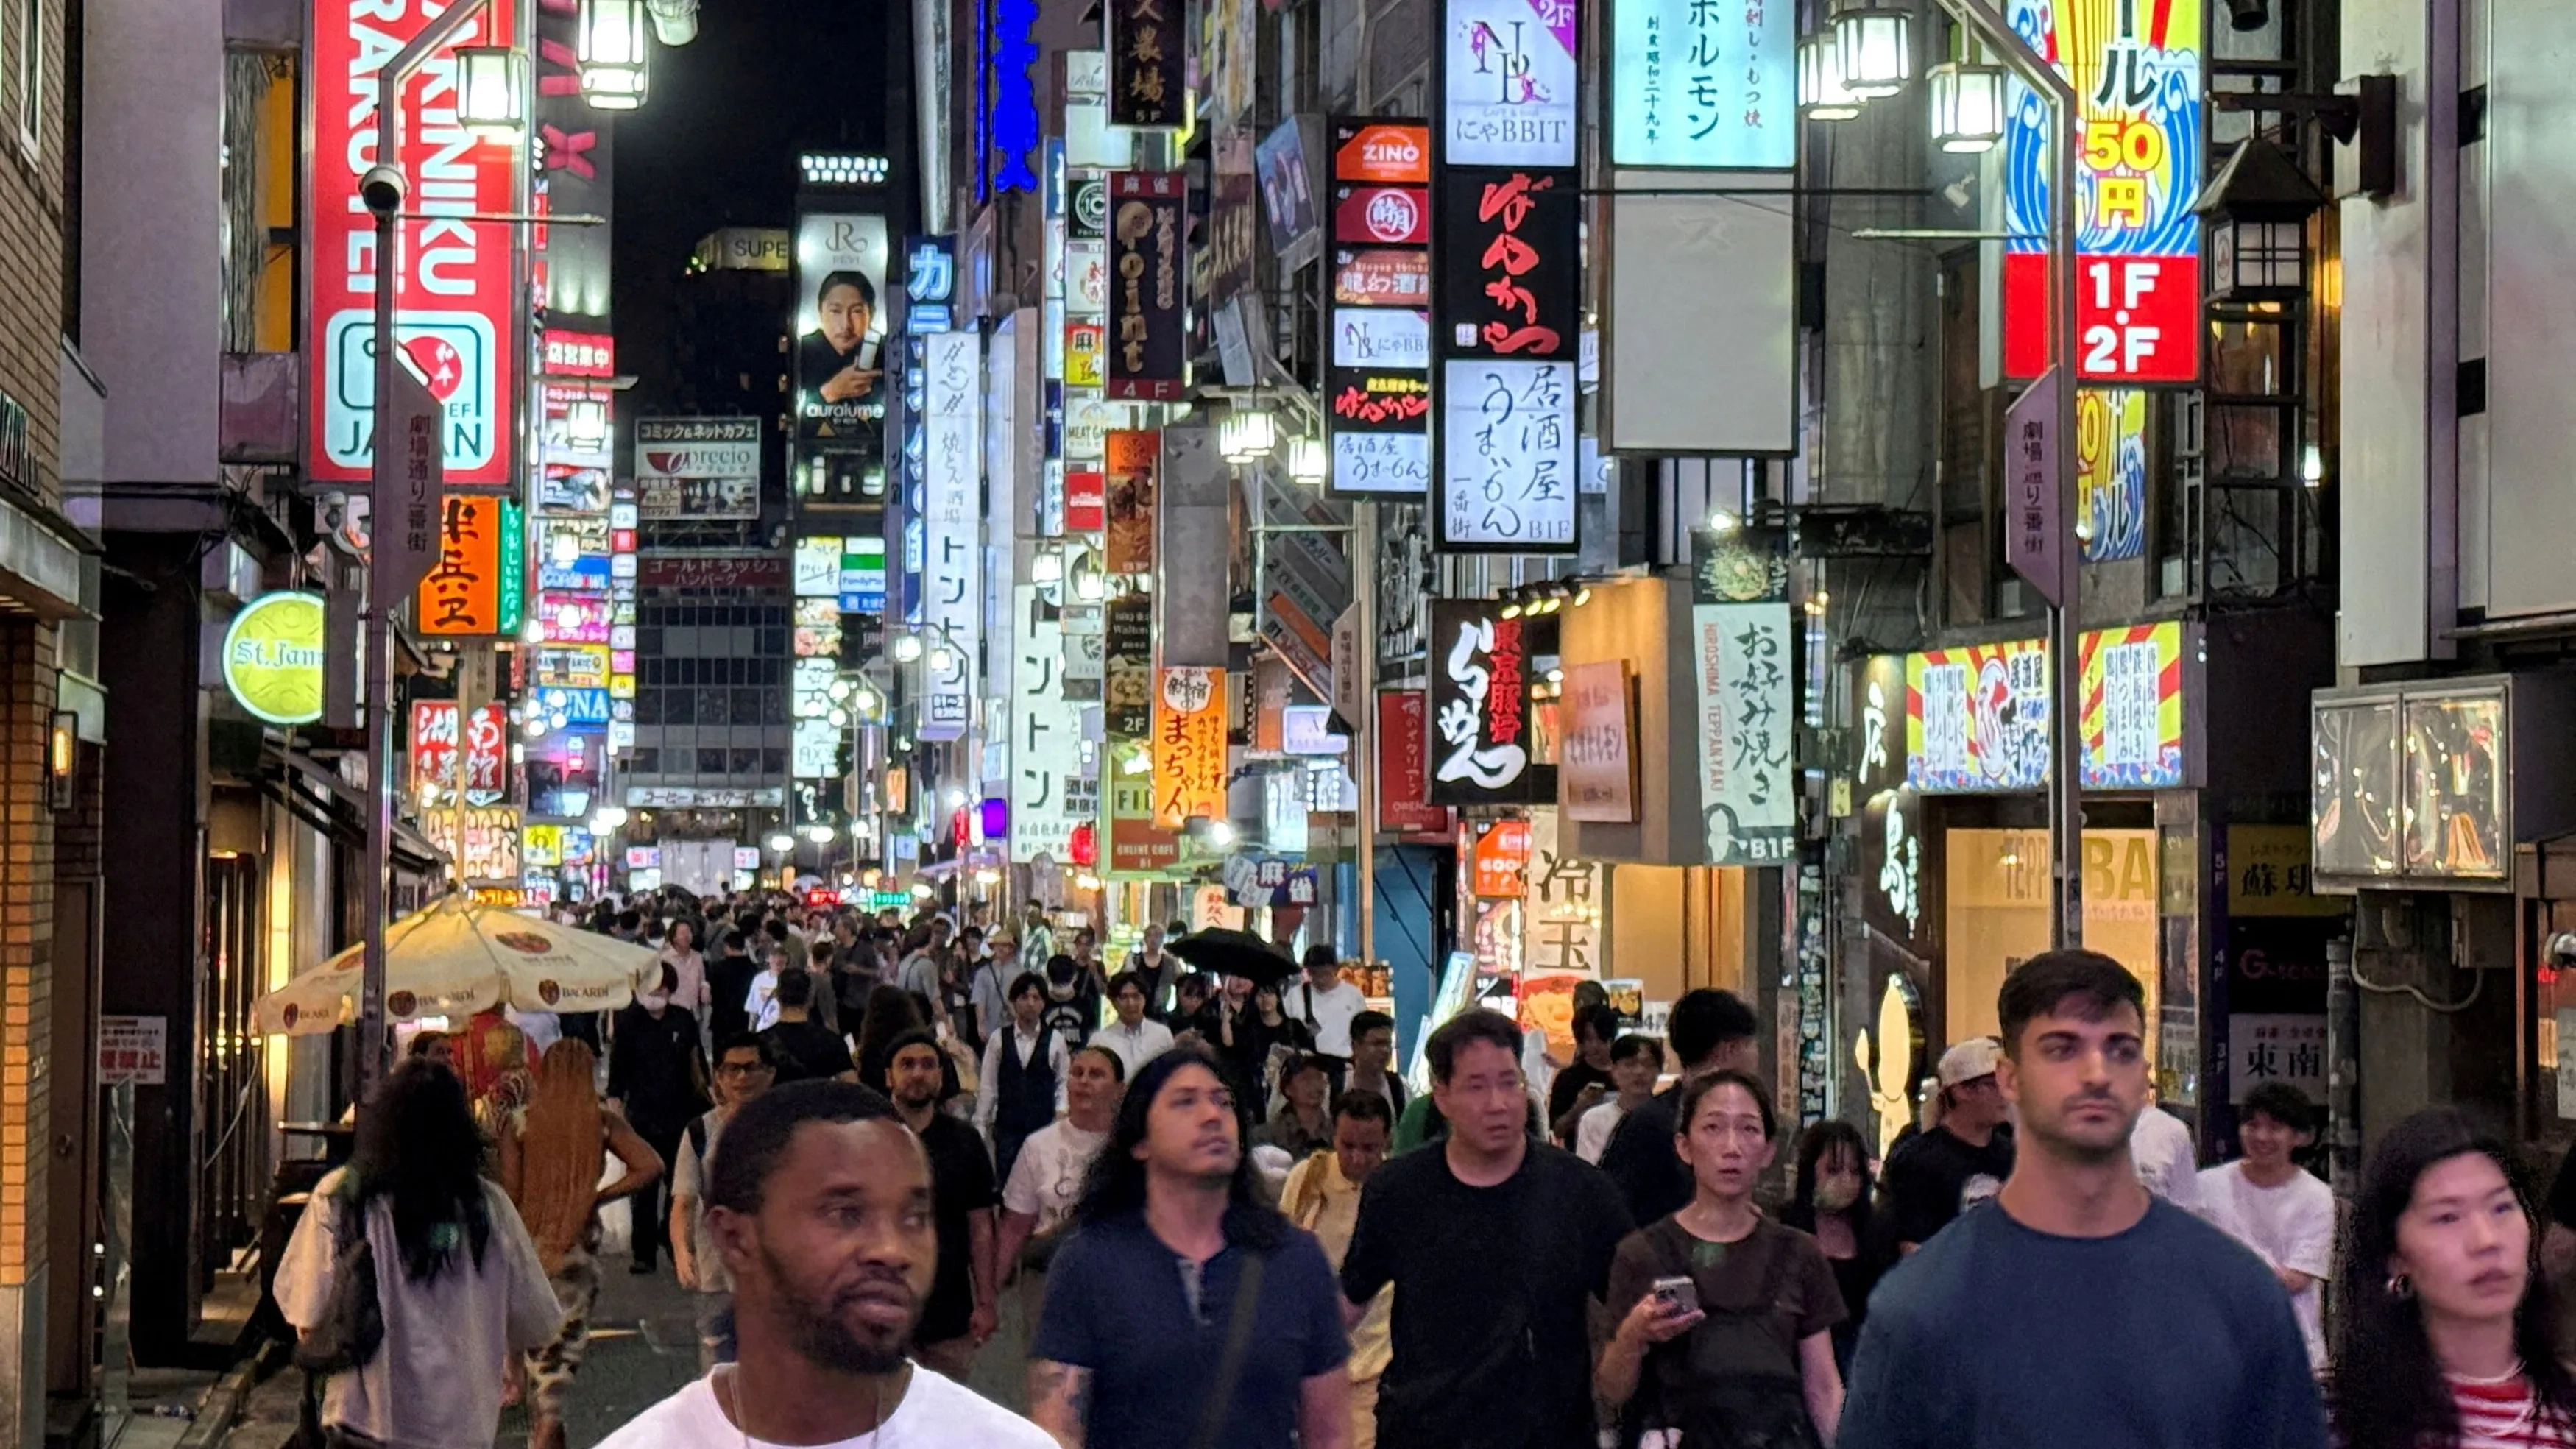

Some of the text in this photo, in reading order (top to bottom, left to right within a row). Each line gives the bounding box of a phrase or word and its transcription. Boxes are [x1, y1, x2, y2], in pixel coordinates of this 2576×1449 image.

[1688, 0, 1720, 140] ホルモン
[1362, 144, 1420, 163] ZINO
[1456, 118, 1567, 144] にゃBBIT
[2089, 262, 2161, 309] 1F
[2084, 326, 2161, 374] 2F
[1521, 364, 1565, 502] 居酒屋
[406, 414, 431, 553] 劇場通り一番街
[1704, 623, 1722, 696] HIROSHIMA
[1123, 716, 1146, 733] 2F
[1729, 621, 1788, 807] お好み焼き
[2246, 1041, 2320, 1077] 東南
